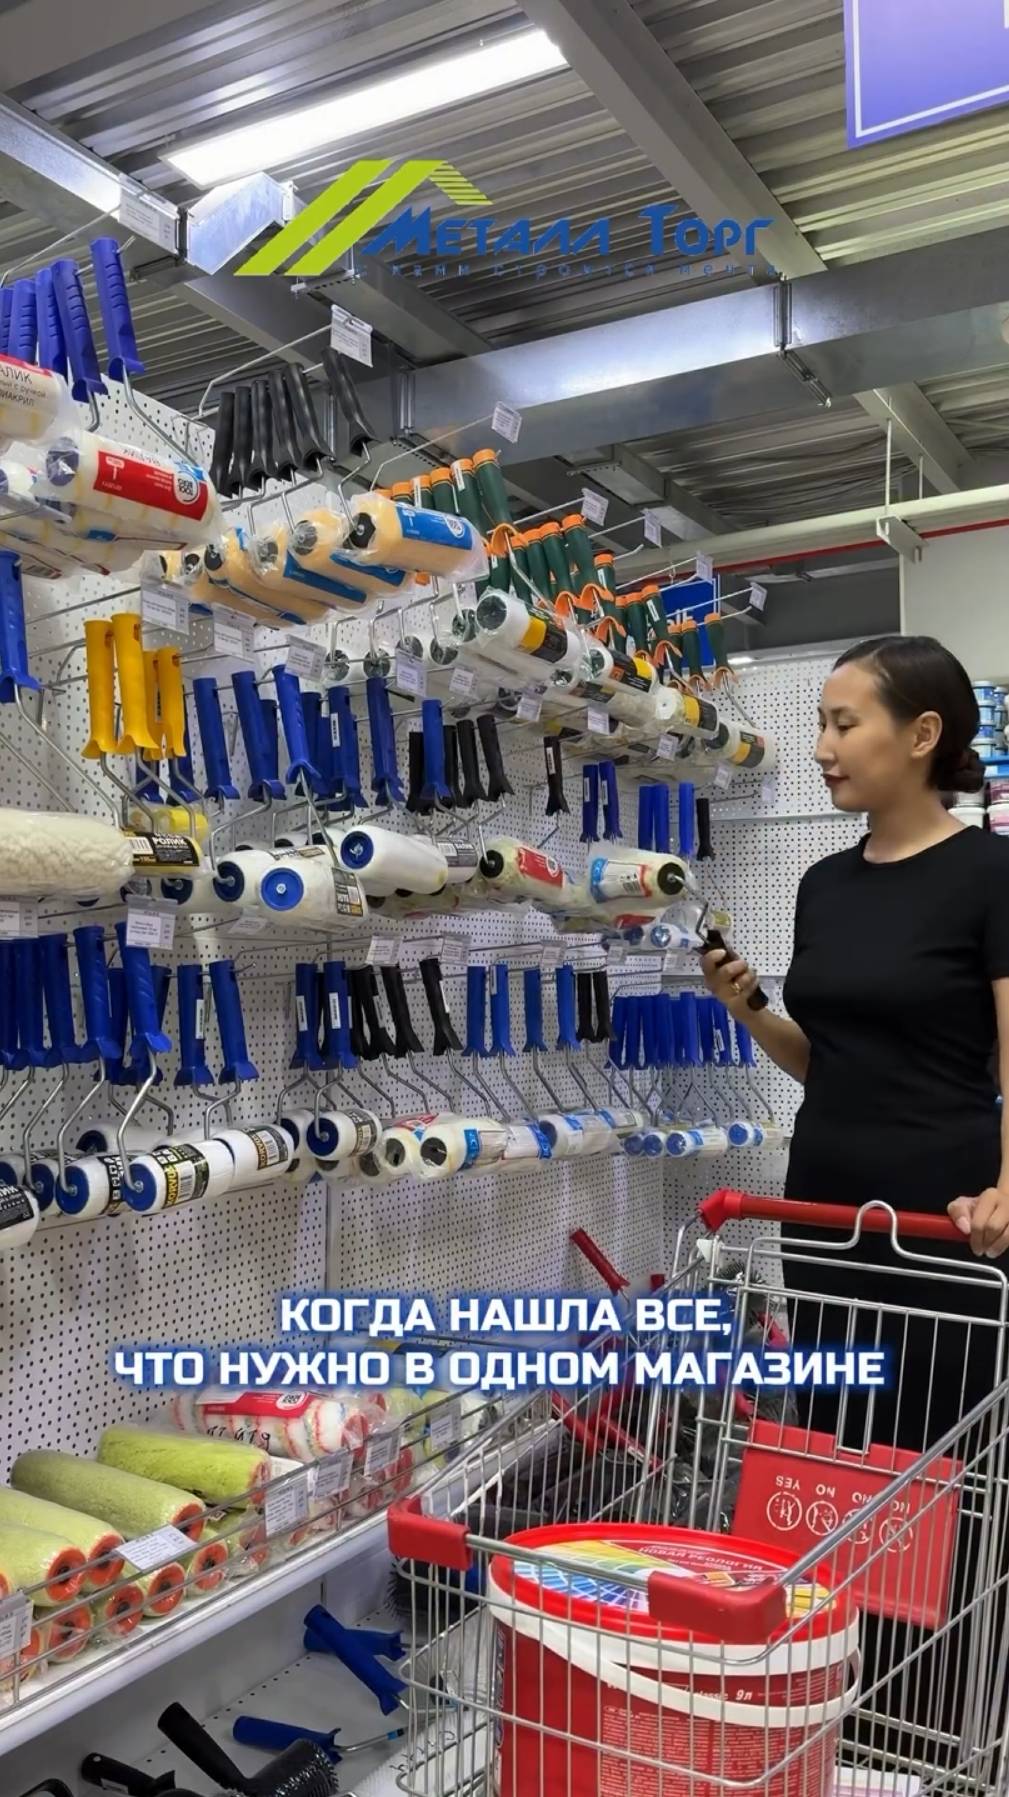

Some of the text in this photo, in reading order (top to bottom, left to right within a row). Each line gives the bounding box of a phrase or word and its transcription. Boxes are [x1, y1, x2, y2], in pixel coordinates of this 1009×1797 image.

[152, 836, 188, 846] РОЛИК
[776, 1475, 801, 1490] YES
[815, 1484, 836, 1498] NO
[852, 1492, 873, 1504] NO
[735, 1688, 754, 1701] 9л
